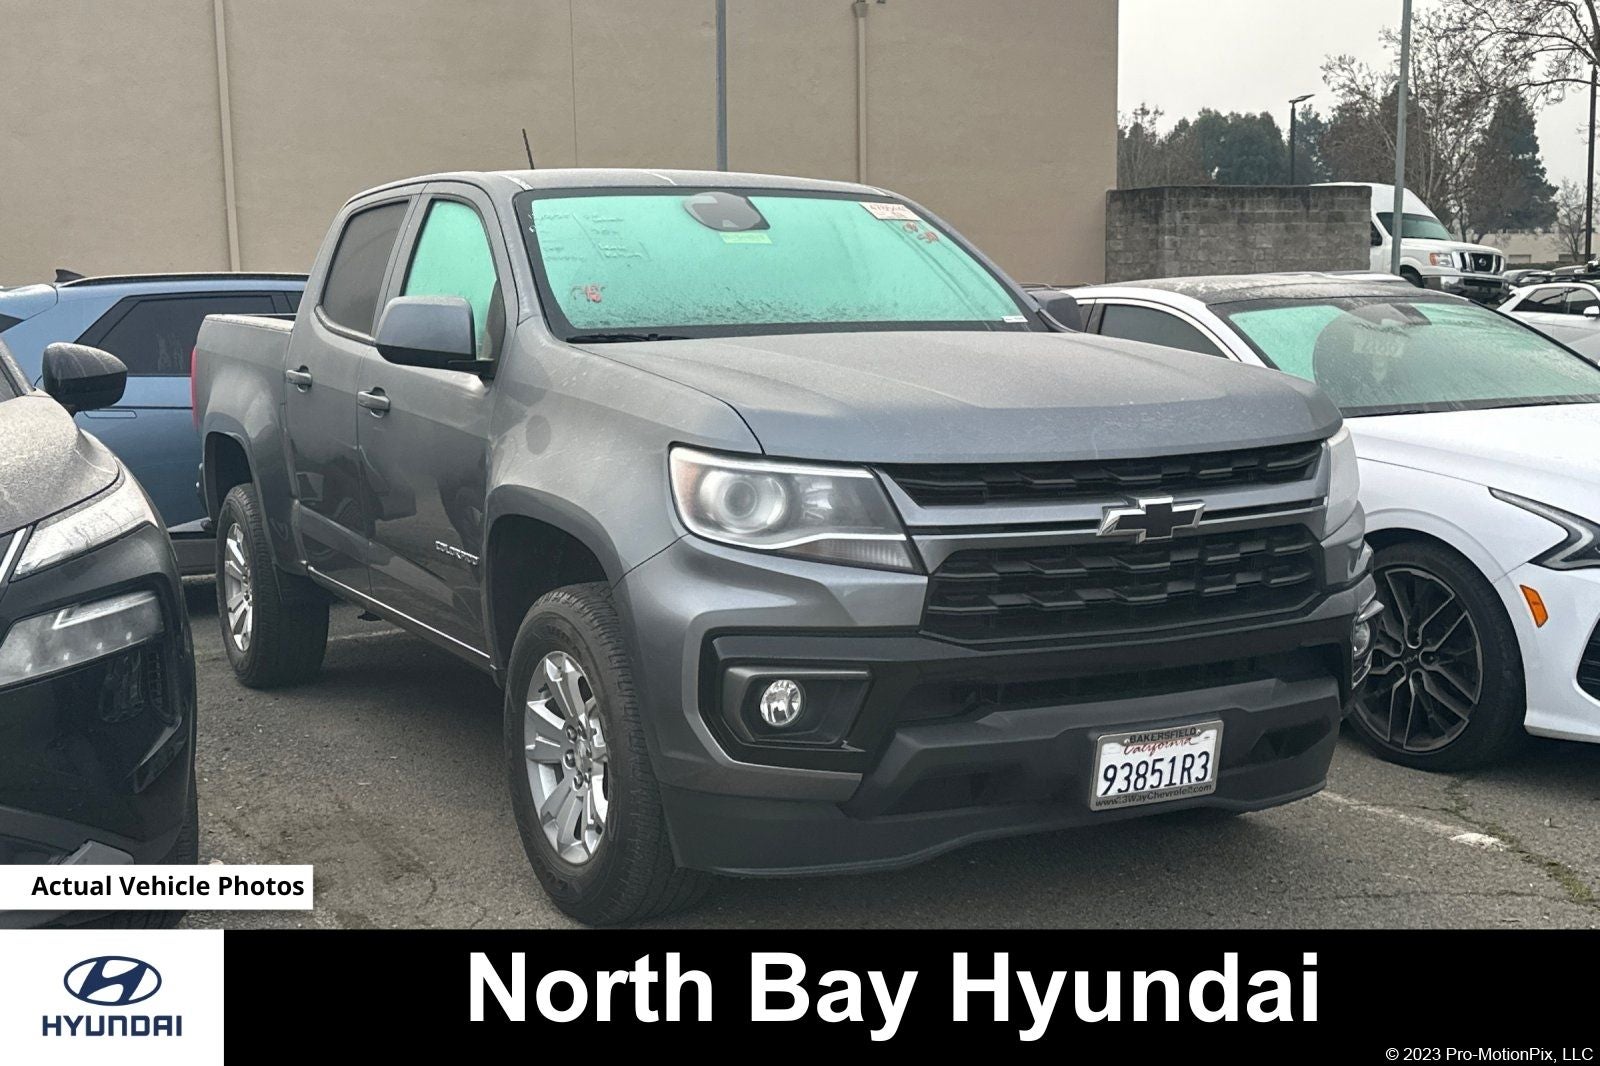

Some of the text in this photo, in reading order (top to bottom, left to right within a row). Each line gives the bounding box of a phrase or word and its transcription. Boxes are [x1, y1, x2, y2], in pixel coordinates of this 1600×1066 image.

[1129, 726, 1197, 743] BAKERSFIELD
[1122, 737, 1195, 757] California
[1101, 751, 1210, 795] 93851R3
